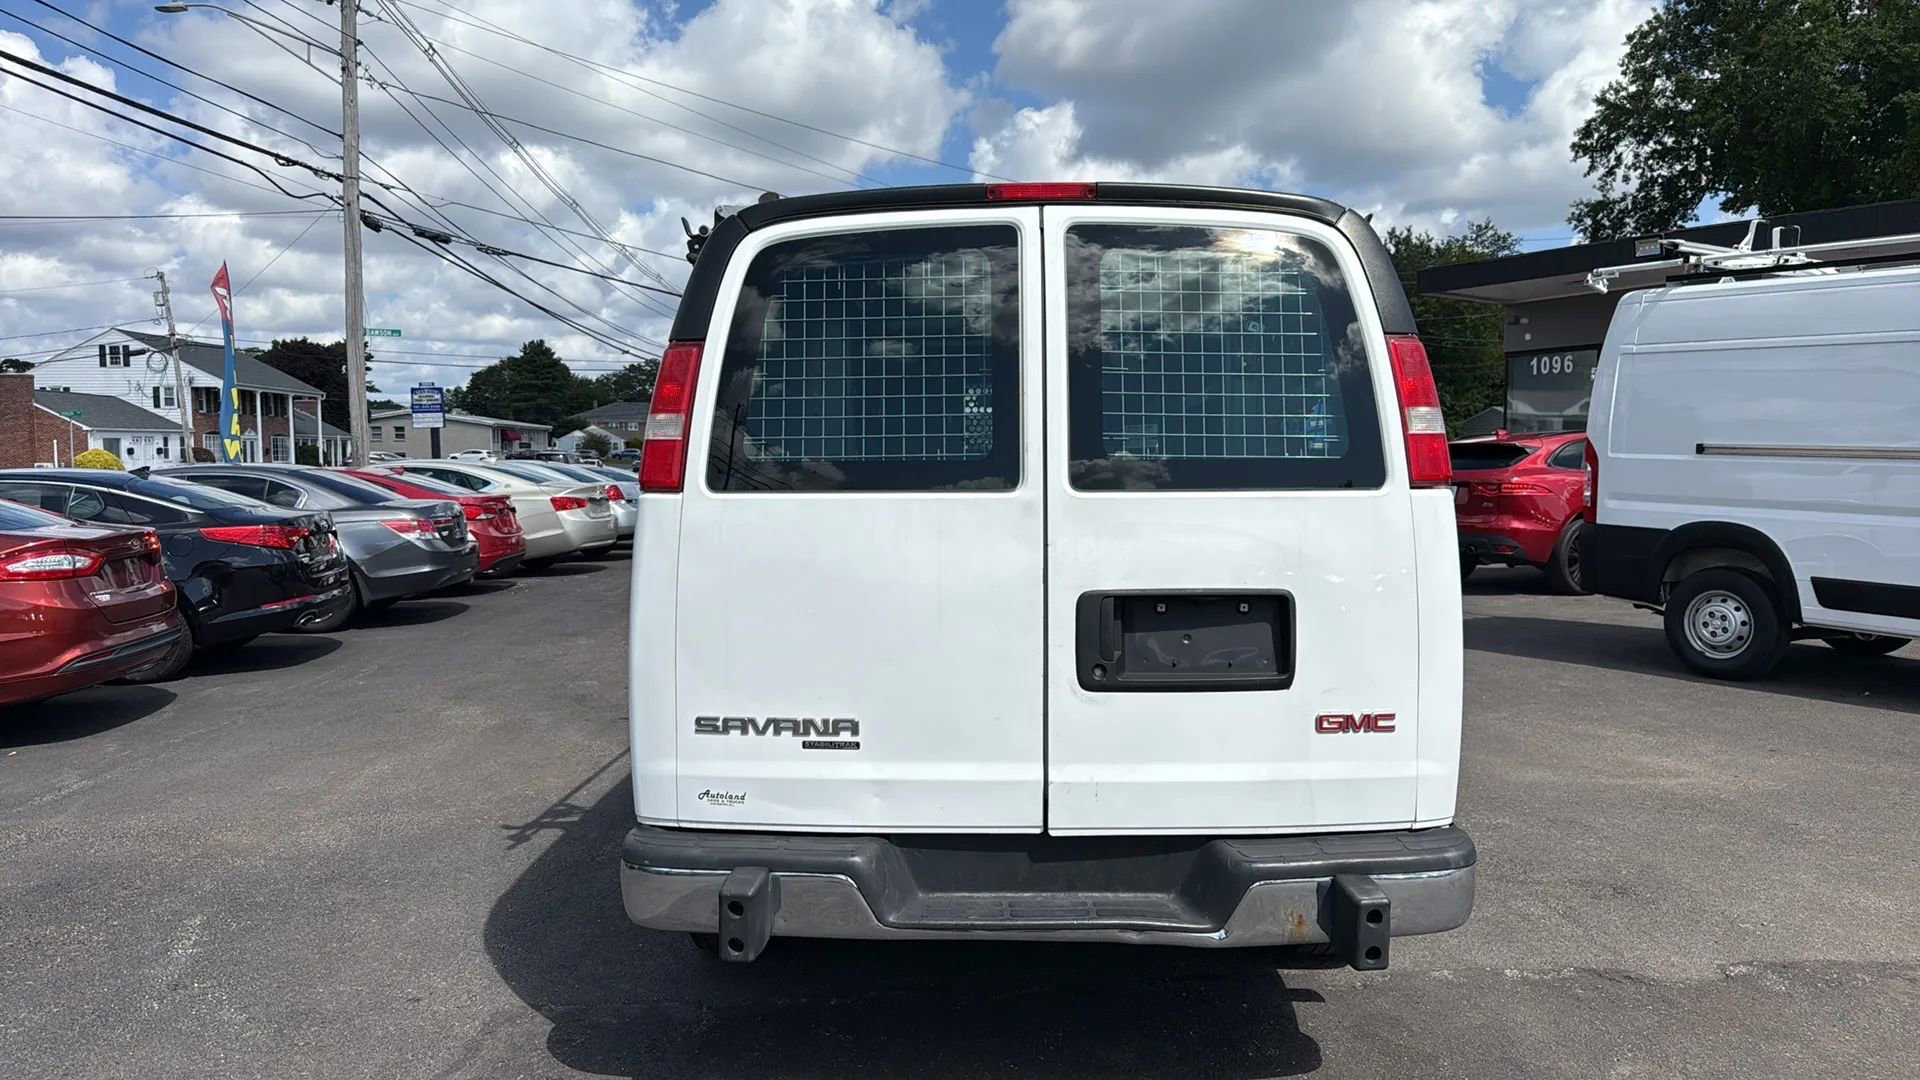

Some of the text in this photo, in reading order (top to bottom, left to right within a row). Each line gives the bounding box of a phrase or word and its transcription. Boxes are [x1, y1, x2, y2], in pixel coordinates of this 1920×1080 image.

[1530, 355, 1573, 376] 1096
[694, 716, 860, 737] SAVANA
[1315, 713, 1396, 734] GMC
[698, 789, 747, 801] Autoland
